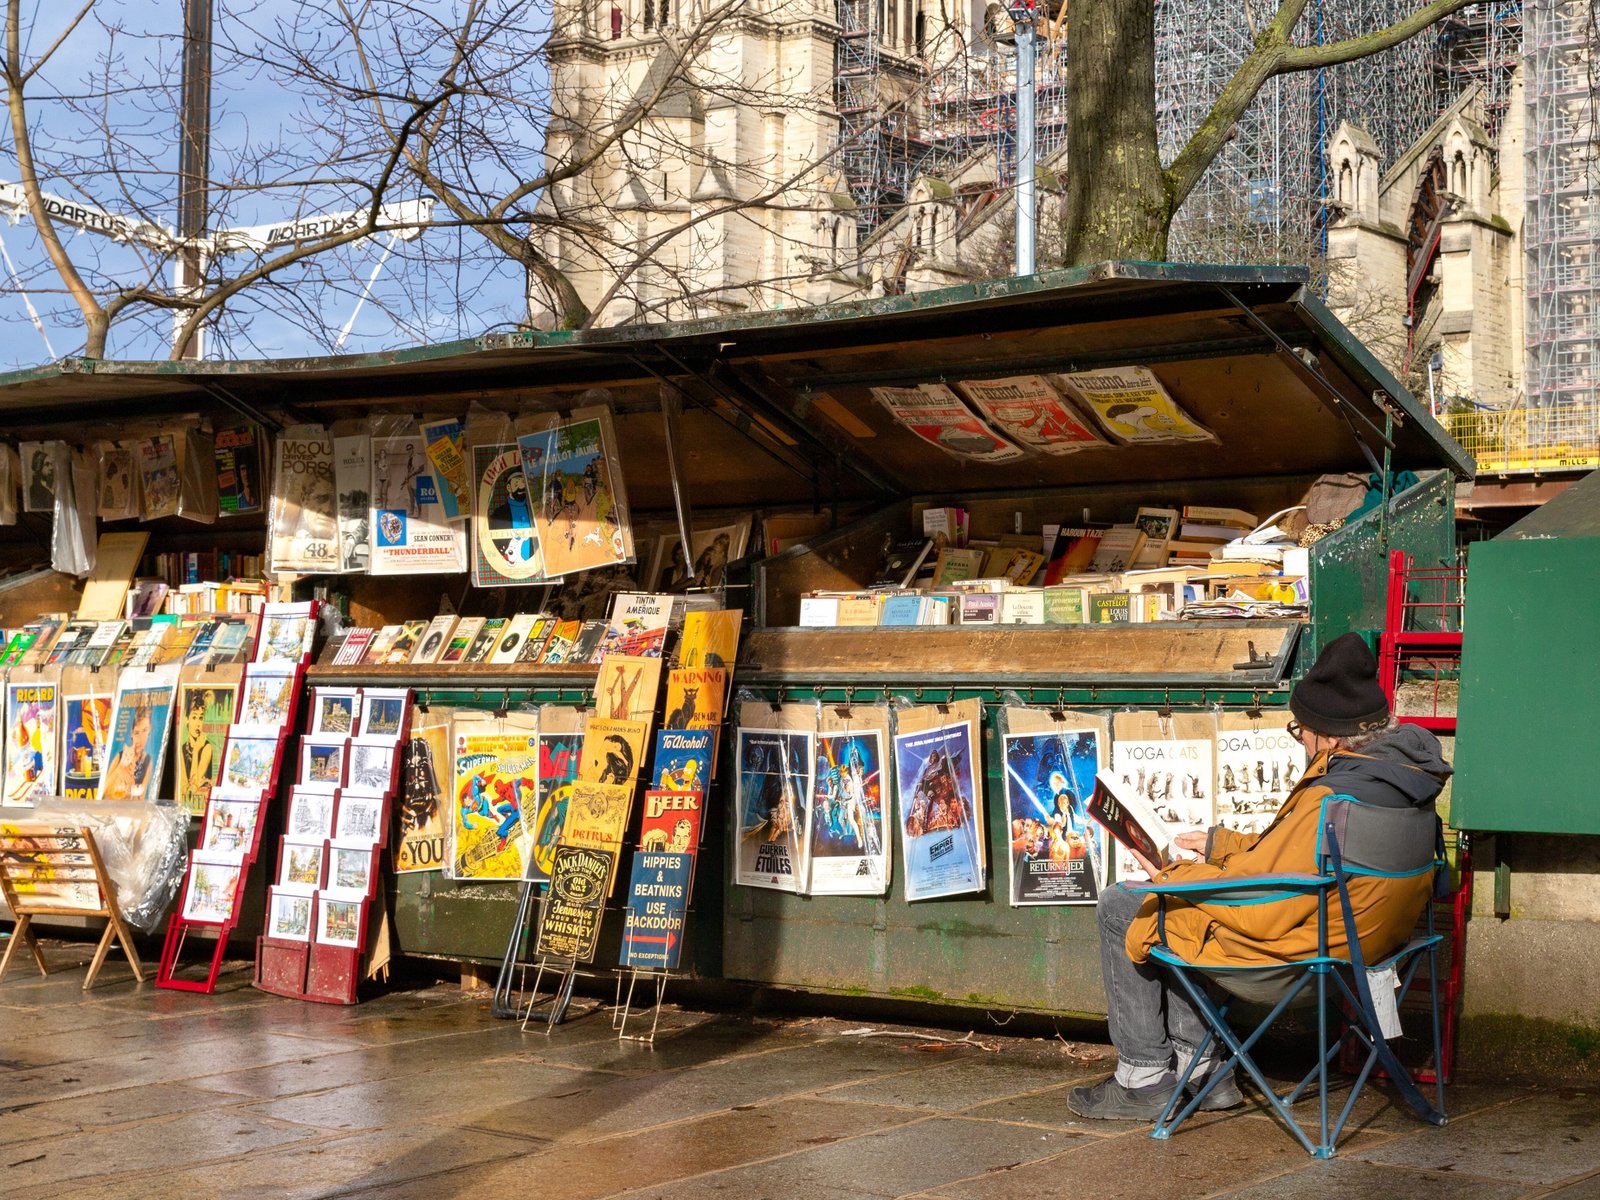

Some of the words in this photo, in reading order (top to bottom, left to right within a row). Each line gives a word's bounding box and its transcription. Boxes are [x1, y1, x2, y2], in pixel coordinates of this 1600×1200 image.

[282, 441, 332, 456] McQU
[527, 460, 537, 469] LE
[574, 443, 600, 458] JAUNE
[420, 488, 435, 496] RO
[428, 534, 455, 542] CONNERY
[1060, 527, 1086, 537] HAROUN
[1086, 528, 1104, 538] TAZIE
[636, 596, 656, 604] TINTIN
[672, 671, 722, 684] WARNING
[16, 687, 54, 703] RICARD
[694, 711, 717, 722] BEWARE
[673, 735, 709, 749] Alcohol!
[1217, 737, 1251, 752] OGA
[1255, 735, 1297, 751] DOGS
[1125, 746, 1165, 760] YOGA
[457, 754, 499, 776] SUPERMAN
[645, 795, 700, 818] BEER
[406, 838, 444, 866] YOU
[759, 844, 789, 857] GUERRE
[929, 837, 954, 855] EMPIRE
[557, 855, 578, 874] JACK
[578, 853, 607, 880] DANIEL'S
[642, 856, 681, 869] HIPPIES
[1029, 862, 1060, 872] RETURN
[1065, 861, 1084, 876] JEDI
[572, 877, 586, 885] Old
[656, 870, 664, 882] &
[634, 884, 682, 898] BEATNIKS
[552, 900, 593, 920] Tennessee
[646, 902, 666, 914] USE
[550, 914, 570, 922] SOUR
[626, 915, 682, 930] BACKDOOR
[545, 919, 594, 938] WHISKEY
